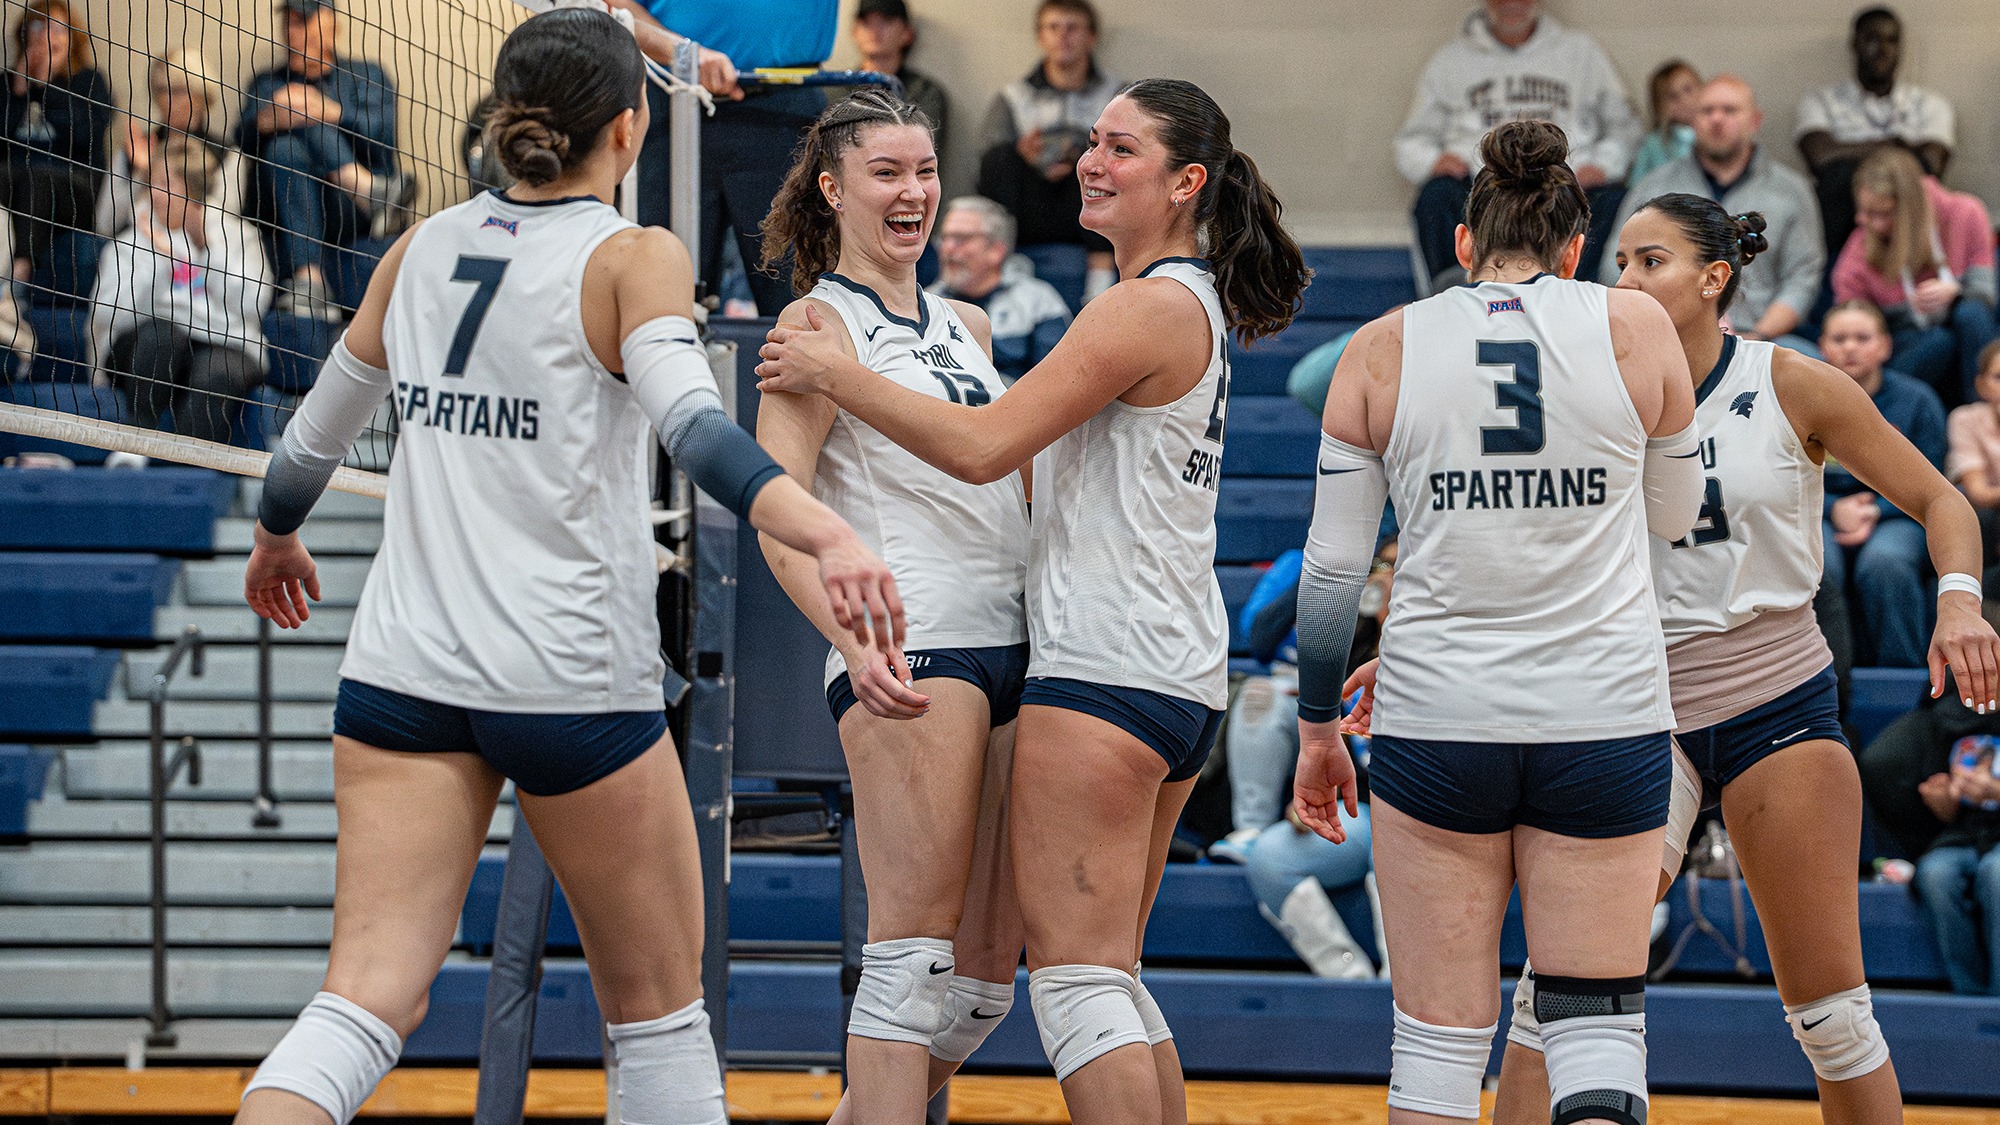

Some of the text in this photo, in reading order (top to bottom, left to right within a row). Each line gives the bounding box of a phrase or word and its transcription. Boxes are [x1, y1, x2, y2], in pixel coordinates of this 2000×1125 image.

[442, 253, 512, 378] 7
[1487, 297, 1525, 315] NAIA
[398, 381, 540, 440] SPRTANS
[1475, 339, 1546, 456] 3
[1429, 467, 1607, 511] SPARTANS
[1669, 475, 1732, 550] 3
